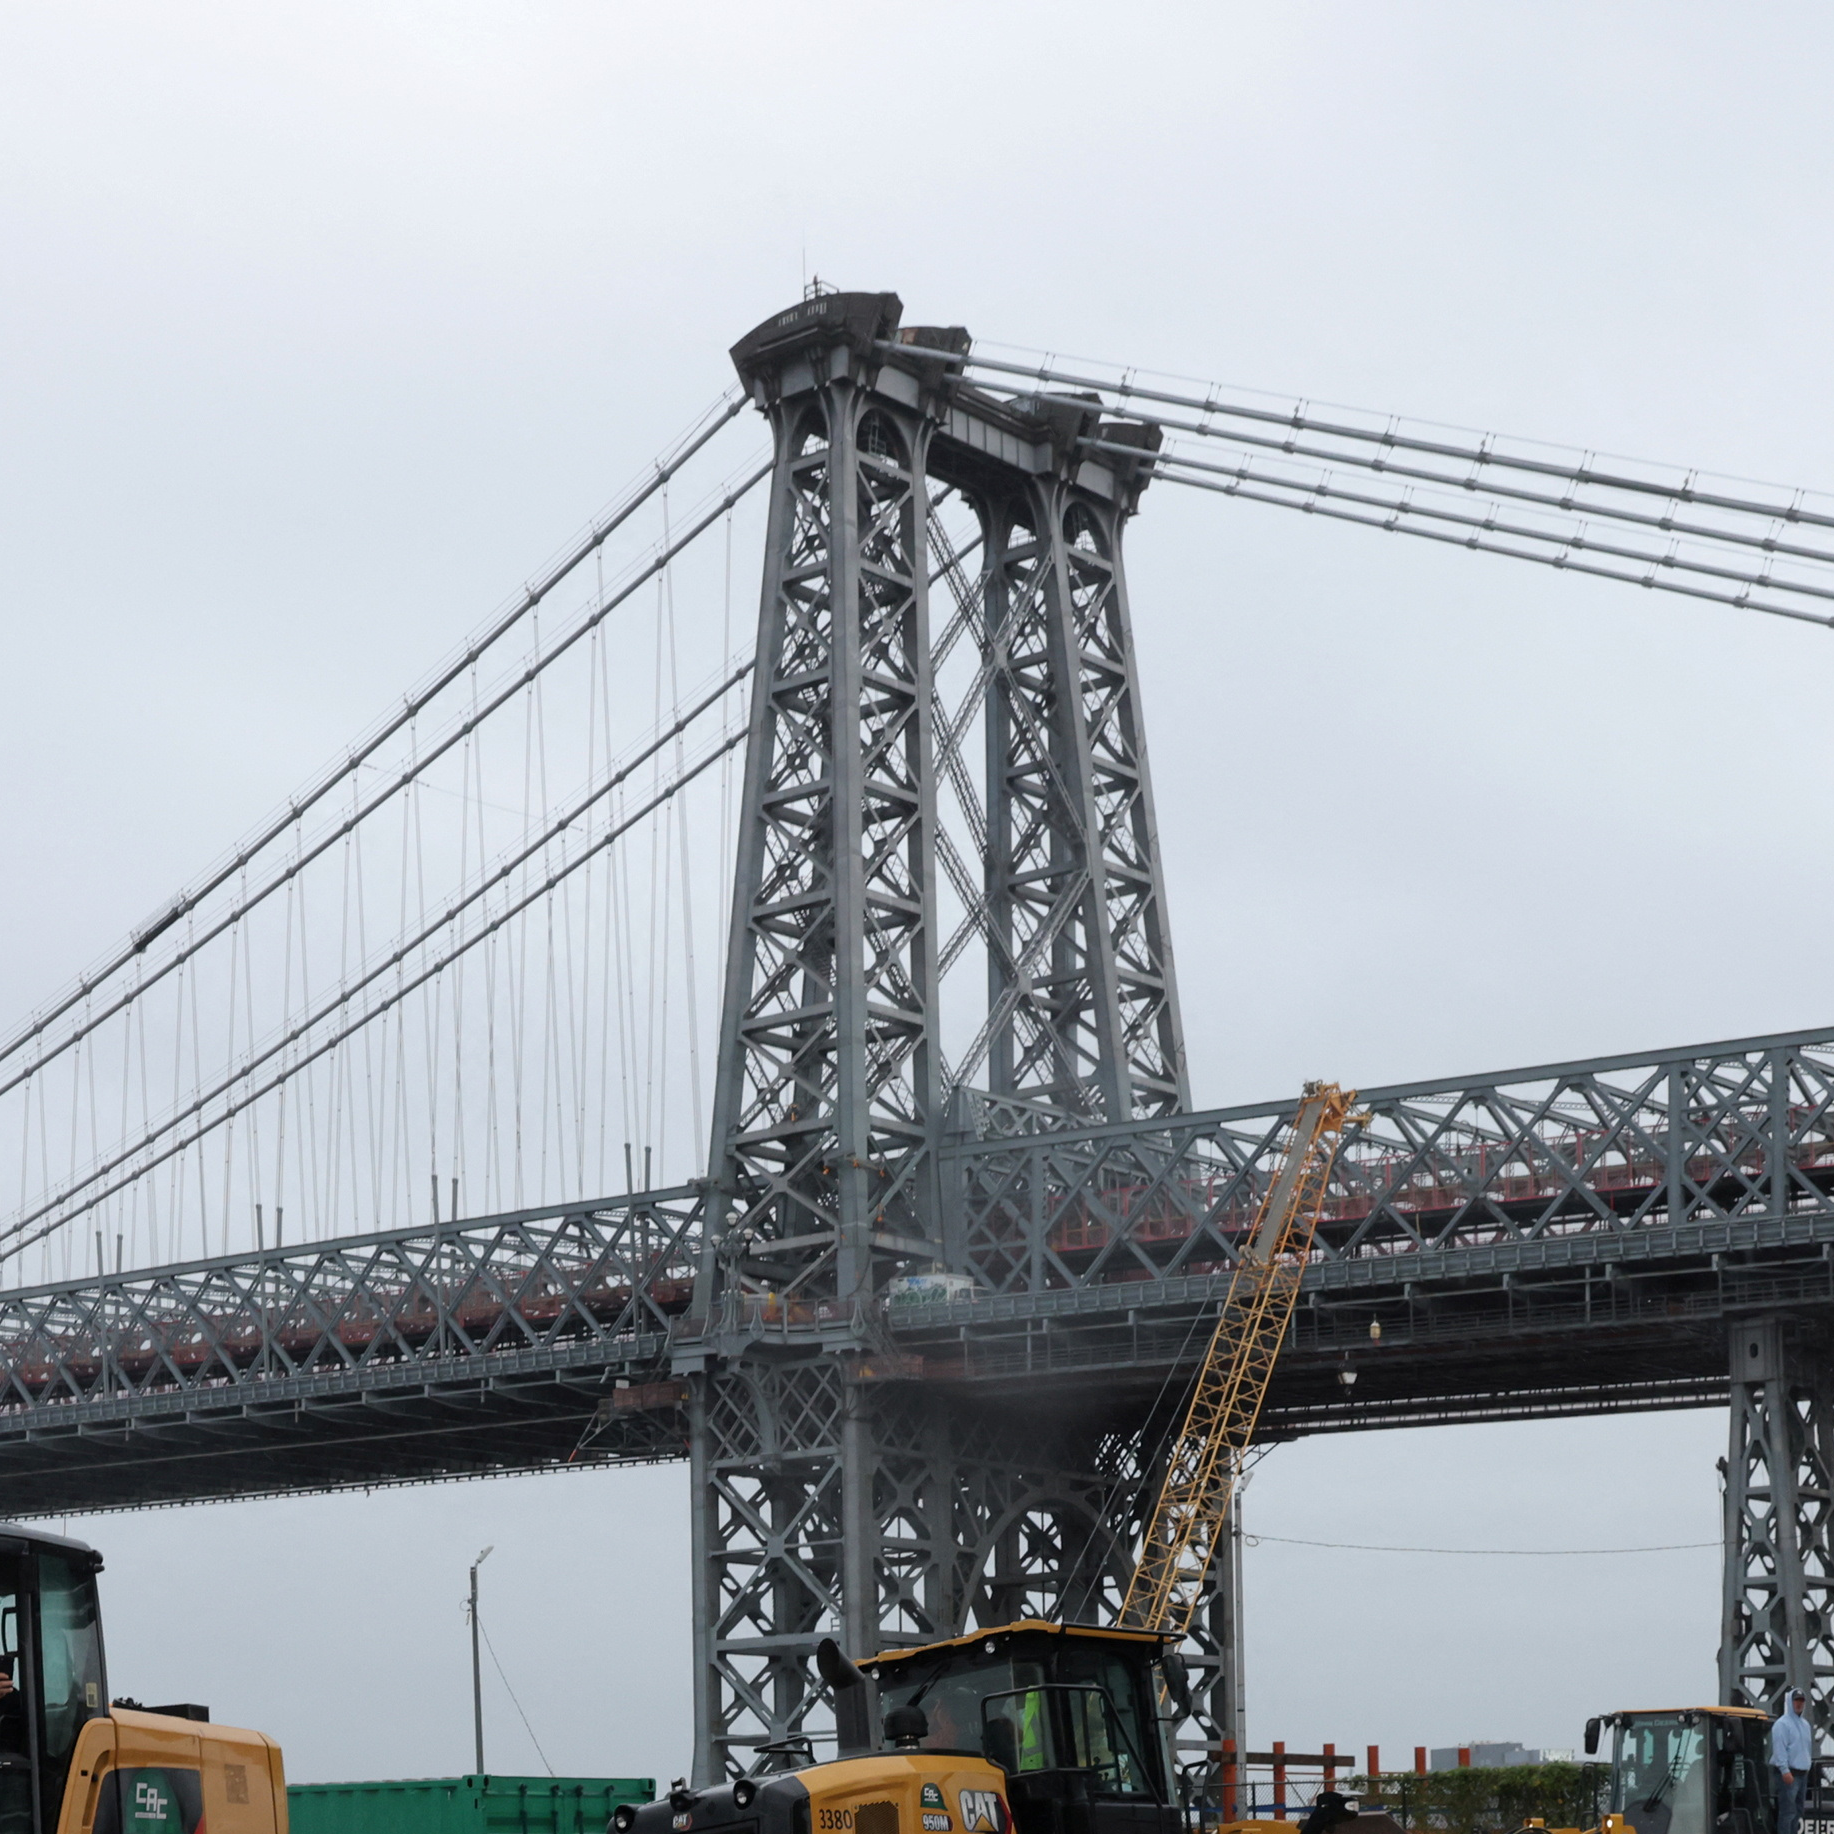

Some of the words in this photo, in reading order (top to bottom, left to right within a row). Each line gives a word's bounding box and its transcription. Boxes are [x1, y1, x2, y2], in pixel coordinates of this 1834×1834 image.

[135, 1782, 168, 1820] CAC
[959, 1789, 999, 1832] CAT
[672, 1813, 689, 1829] CAT
[819, 1809, 853, 1830] 3380
[922, 1814, 949, 1831] 950M
